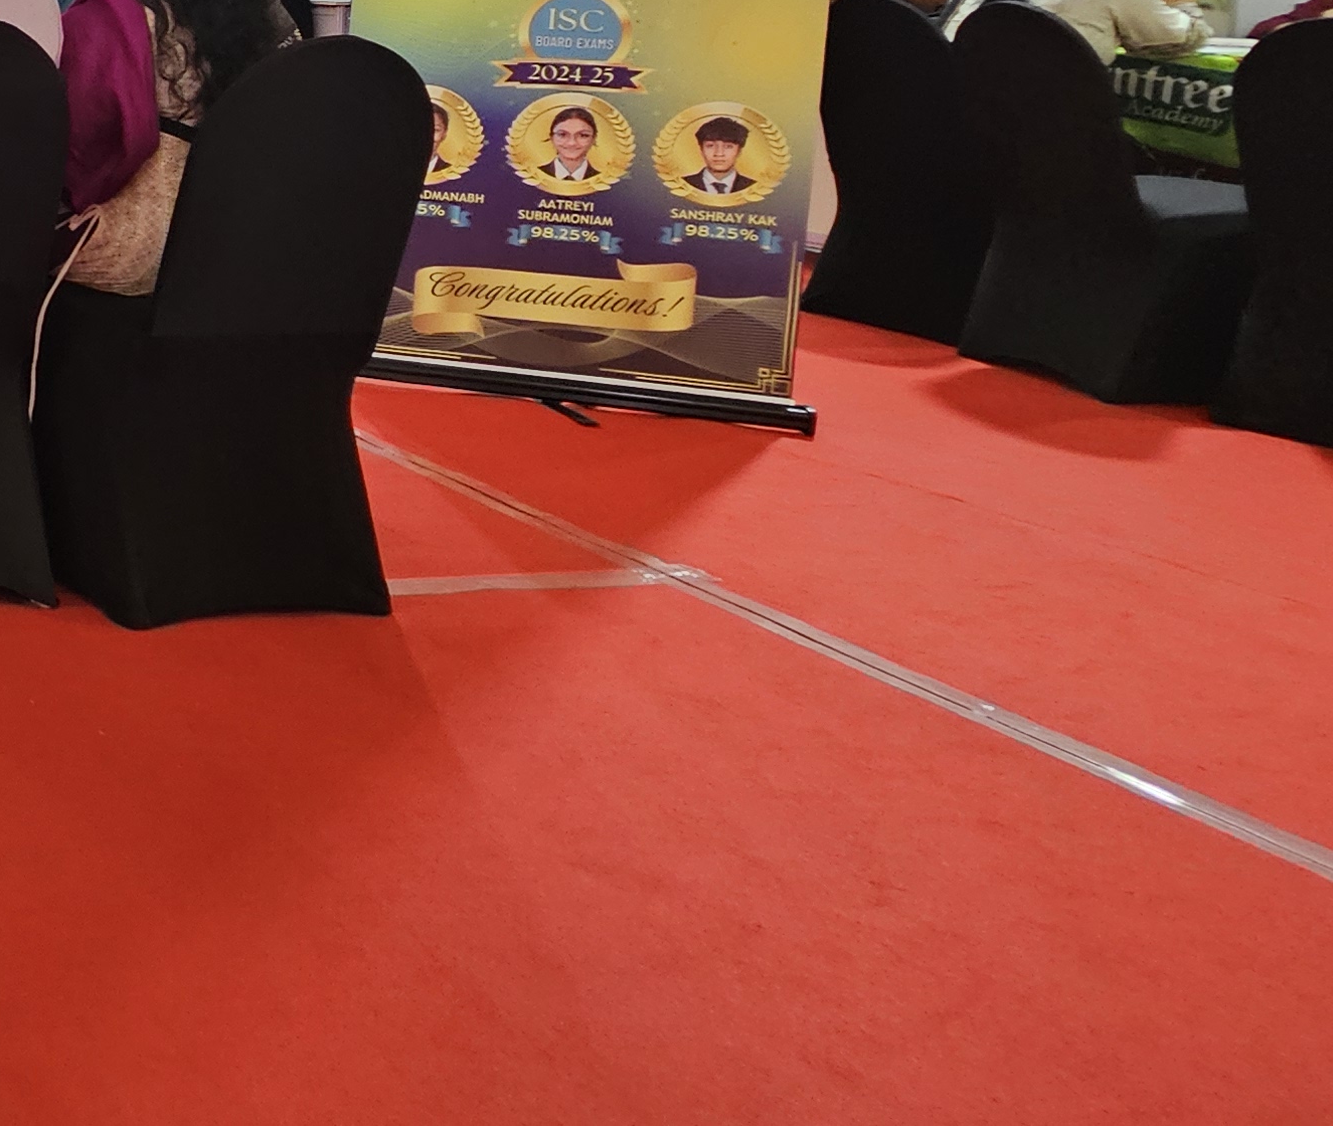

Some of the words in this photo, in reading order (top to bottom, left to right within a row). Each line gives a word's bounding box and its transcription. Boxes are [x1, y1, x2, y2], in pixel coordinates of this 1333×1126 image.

[548, 7, 605, 33] ISC
[535, 35, 573, 48] BOARD
[576, 37, 614, 50] EXAMS
[1112, 65, 1234, 113] ntree
[420, 190, 485, 204] DMANABH
[538, 199, 594, 212] AATREYI
[517, 209, 613, 226] SUBRAMONIAM
[670, 208, 744, 223] SANSHRAY
[748, 215, 778, 226] KAK
[531, 226, 600, 243] 98.25%
[685, 224, 759, 242] 98.25%
[429, 271, 685, 317] Congratulations!
